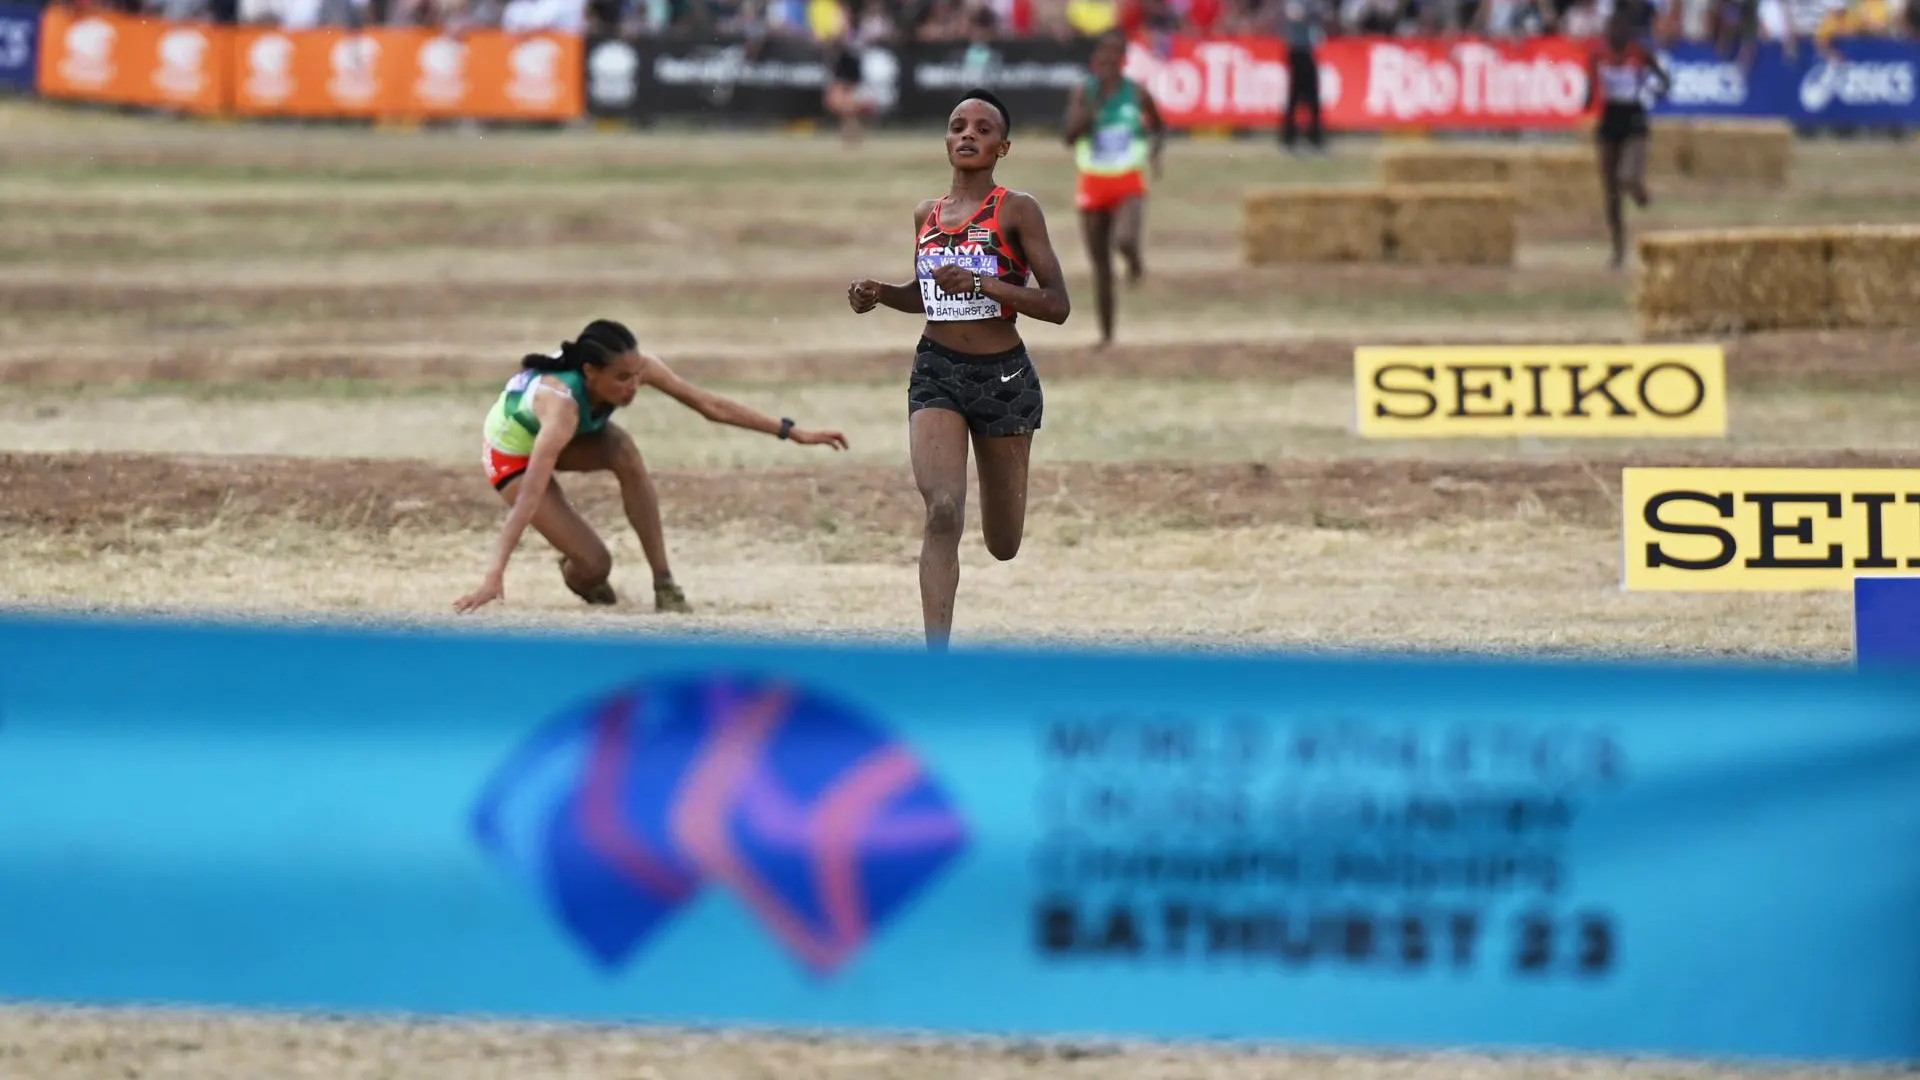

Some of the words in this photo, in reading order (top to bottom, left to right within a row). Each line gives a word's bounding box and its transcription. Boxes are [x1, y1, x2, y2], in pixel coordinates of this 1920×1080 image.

[923, 281, 931, 301] B.
[936, 306, 981, 317] BATHURST
[1372, 362, 1706, 419] SEIKO
[1643, 490, 1920, 570] SEI
[1032, 898, 1478, 965] BATHURST
